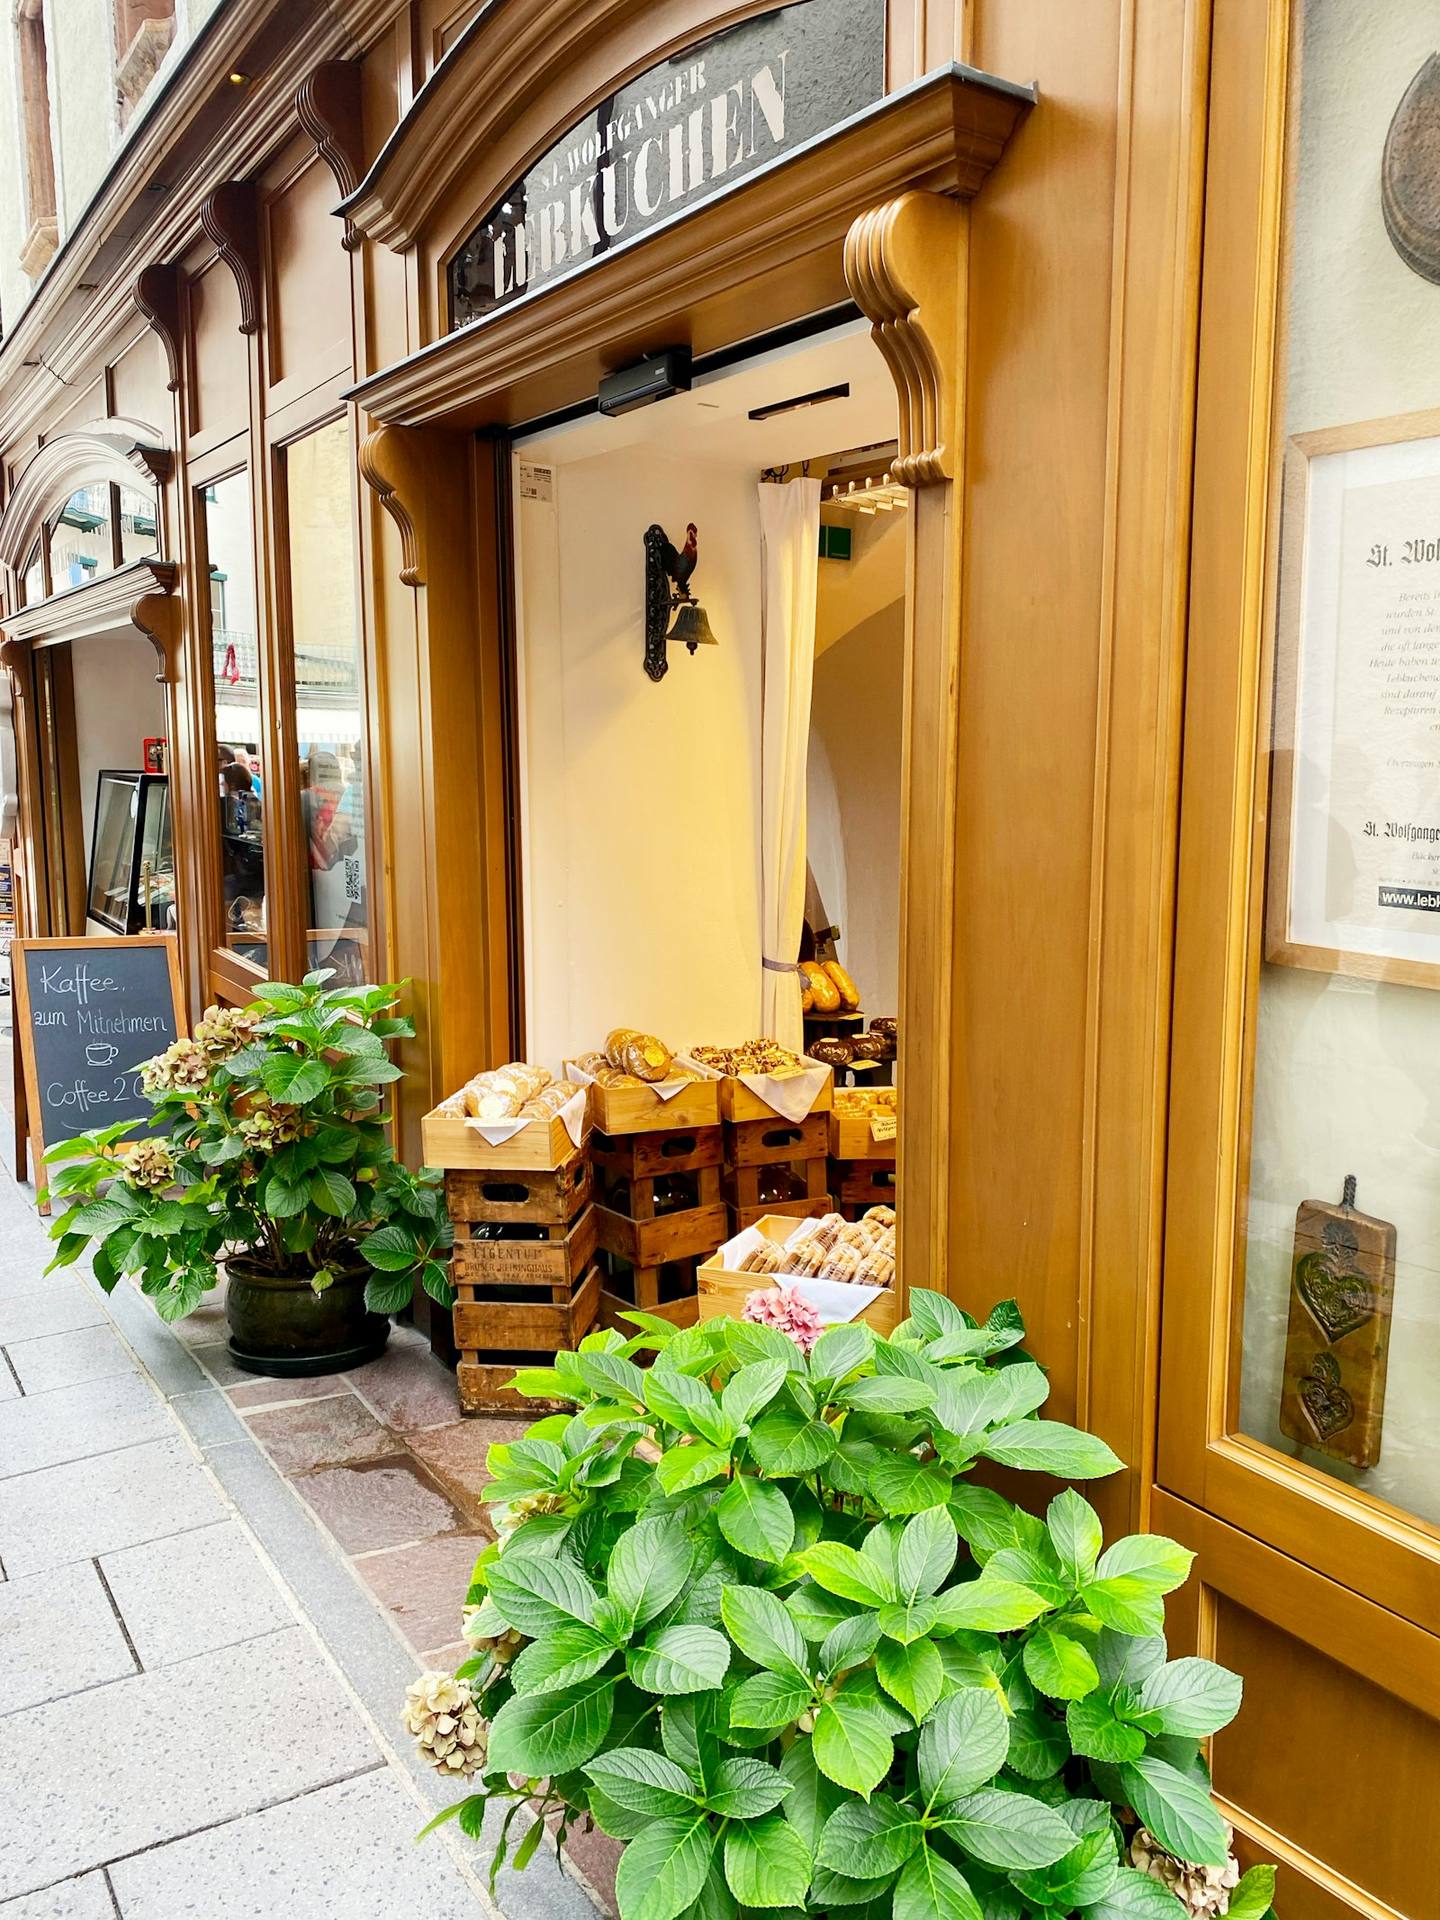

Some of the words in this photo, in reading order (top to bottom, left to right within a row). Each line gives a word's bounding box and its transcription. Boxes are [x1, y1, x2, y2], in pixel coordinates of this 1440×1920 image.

[493, 50, 789, 299] LEBKUCHEN
[33, 1010, 68, 1027] zum
[77, 1008, 168, 1035] Mitnehmen
[47, 1079, 110, 1113] Coffee
